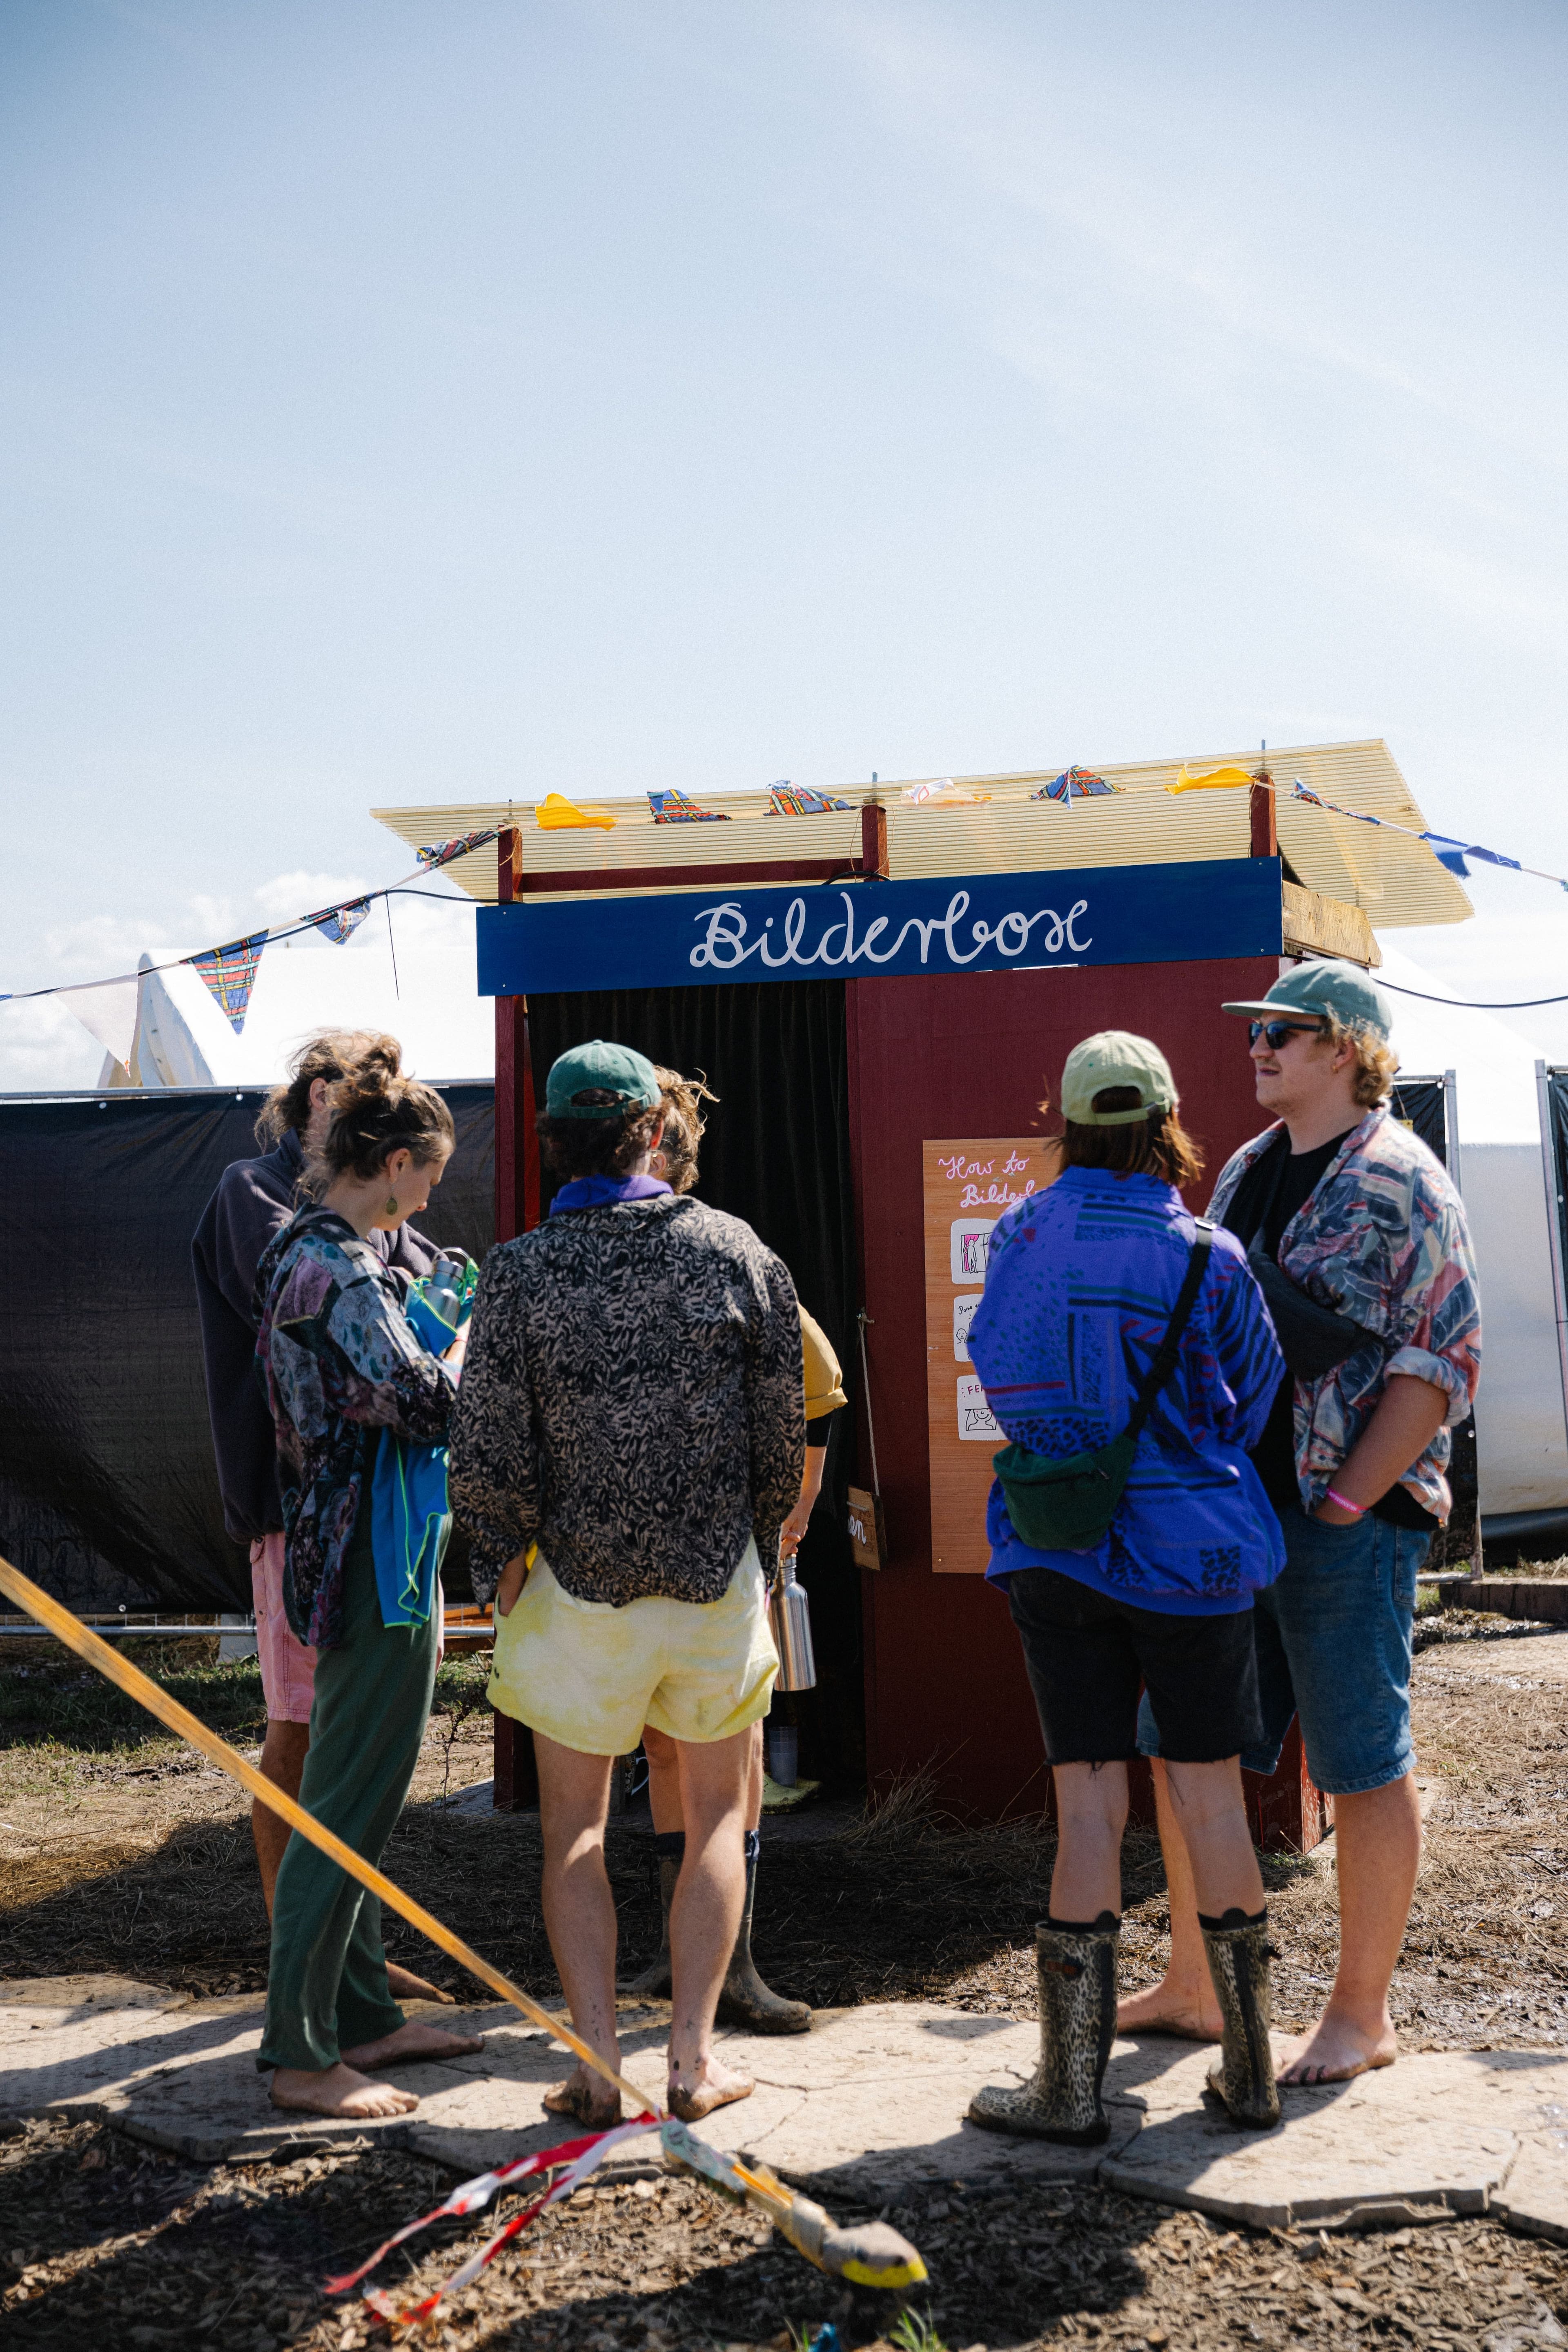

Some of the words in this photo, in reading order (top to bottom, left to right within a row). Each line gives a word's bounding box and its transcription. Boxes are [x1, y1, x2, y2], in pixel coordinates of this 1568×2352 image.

[689, 890, 1093, 969] Bilderbox
[938, 1156, 996, 1179] How
[1002, 1149, 1029, 1174] to
